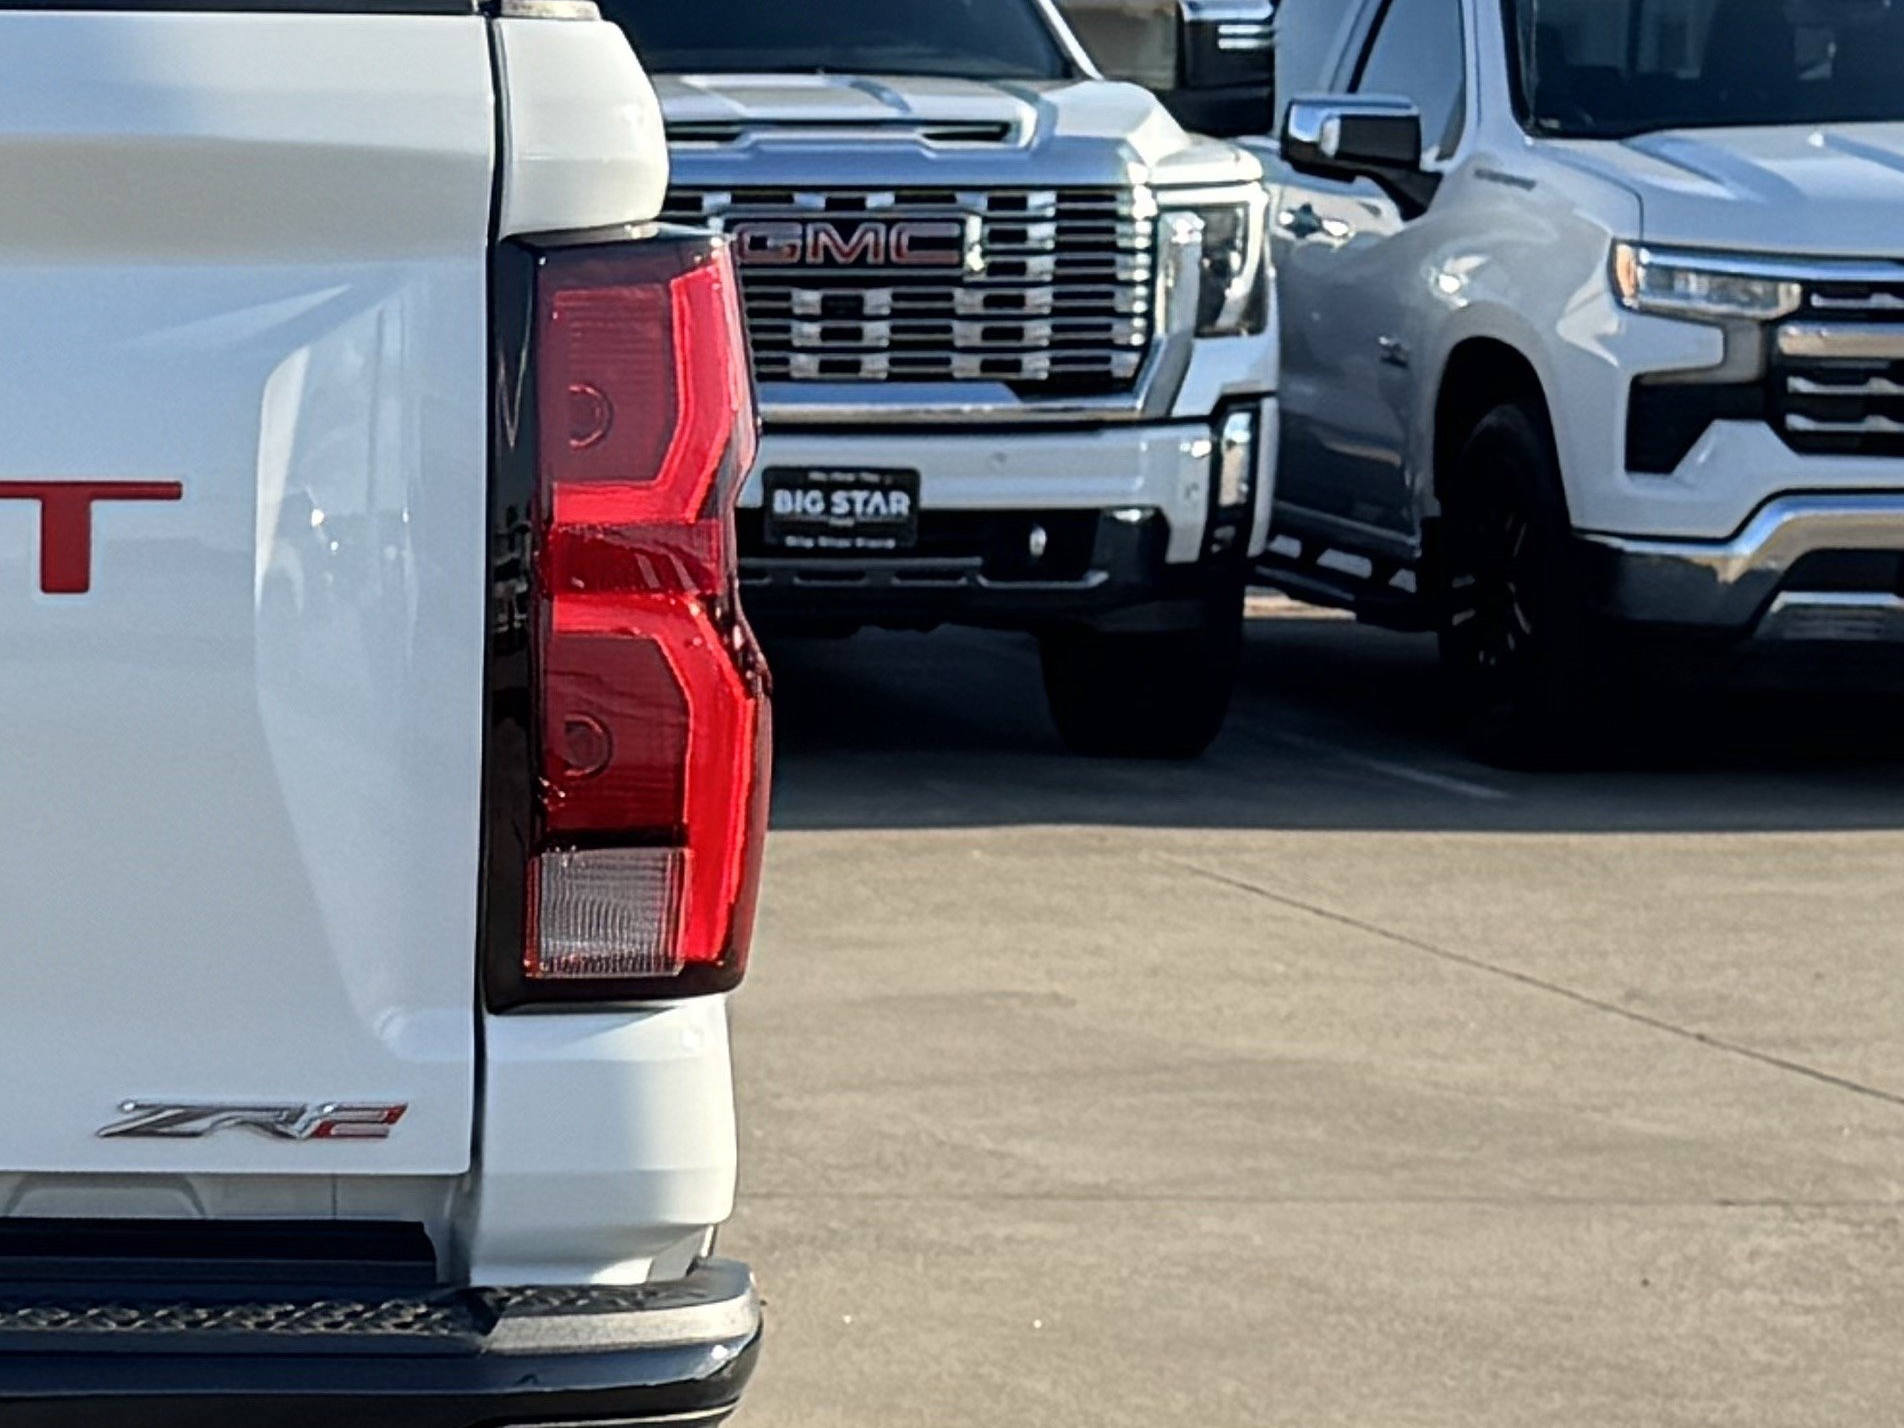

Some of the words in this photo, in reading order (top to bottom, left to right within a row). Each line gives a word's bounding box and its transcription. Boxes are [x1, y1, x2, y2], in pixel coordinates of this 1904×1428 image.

[733, 222, 961, 264] GMC
[773, 489, 825, 514] BIG
[831, 490, 911, 516] STAR
[95, 1100, 409, 1139] ZR2
